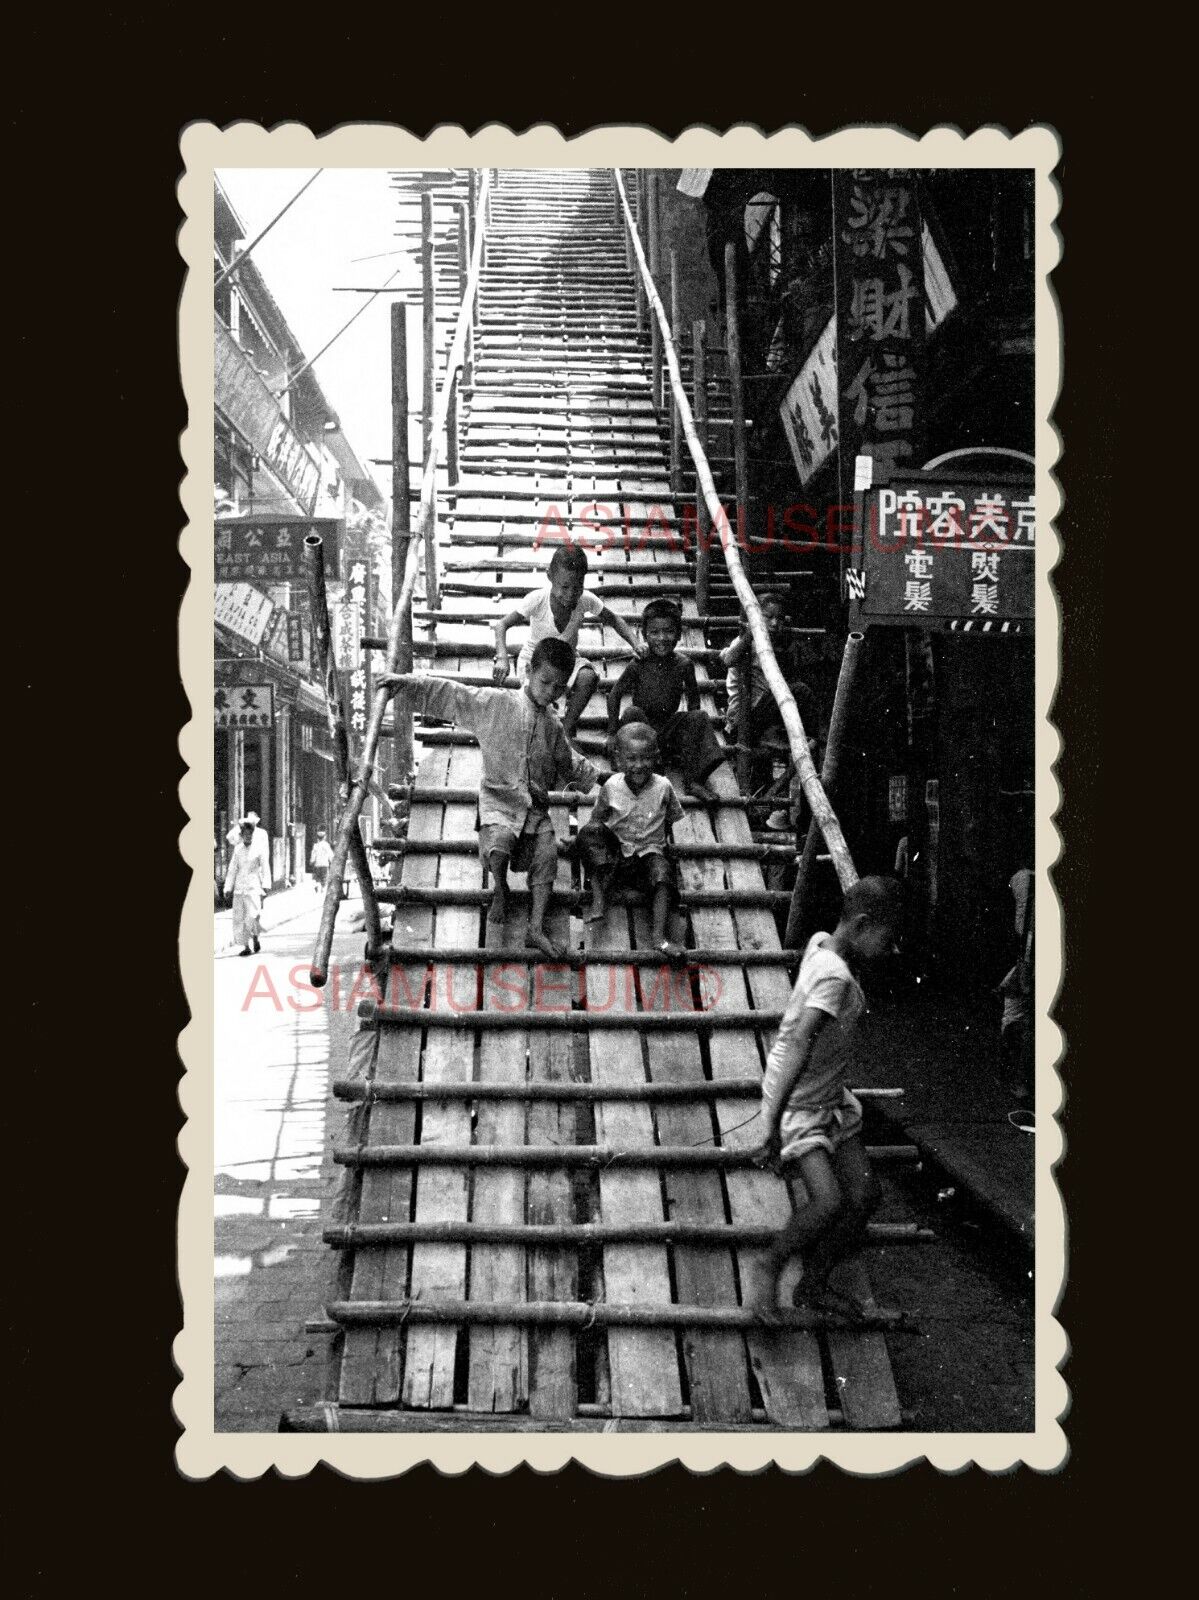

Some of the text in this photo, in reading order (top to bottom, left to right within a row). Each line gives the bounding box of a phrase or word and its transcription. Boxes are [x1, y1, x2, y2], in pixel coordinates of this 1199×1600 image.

[216, 551, 252, 564] EAST
[261, 551, 291, 564] ASIA
[903, 549, 934, 612] 電髮
